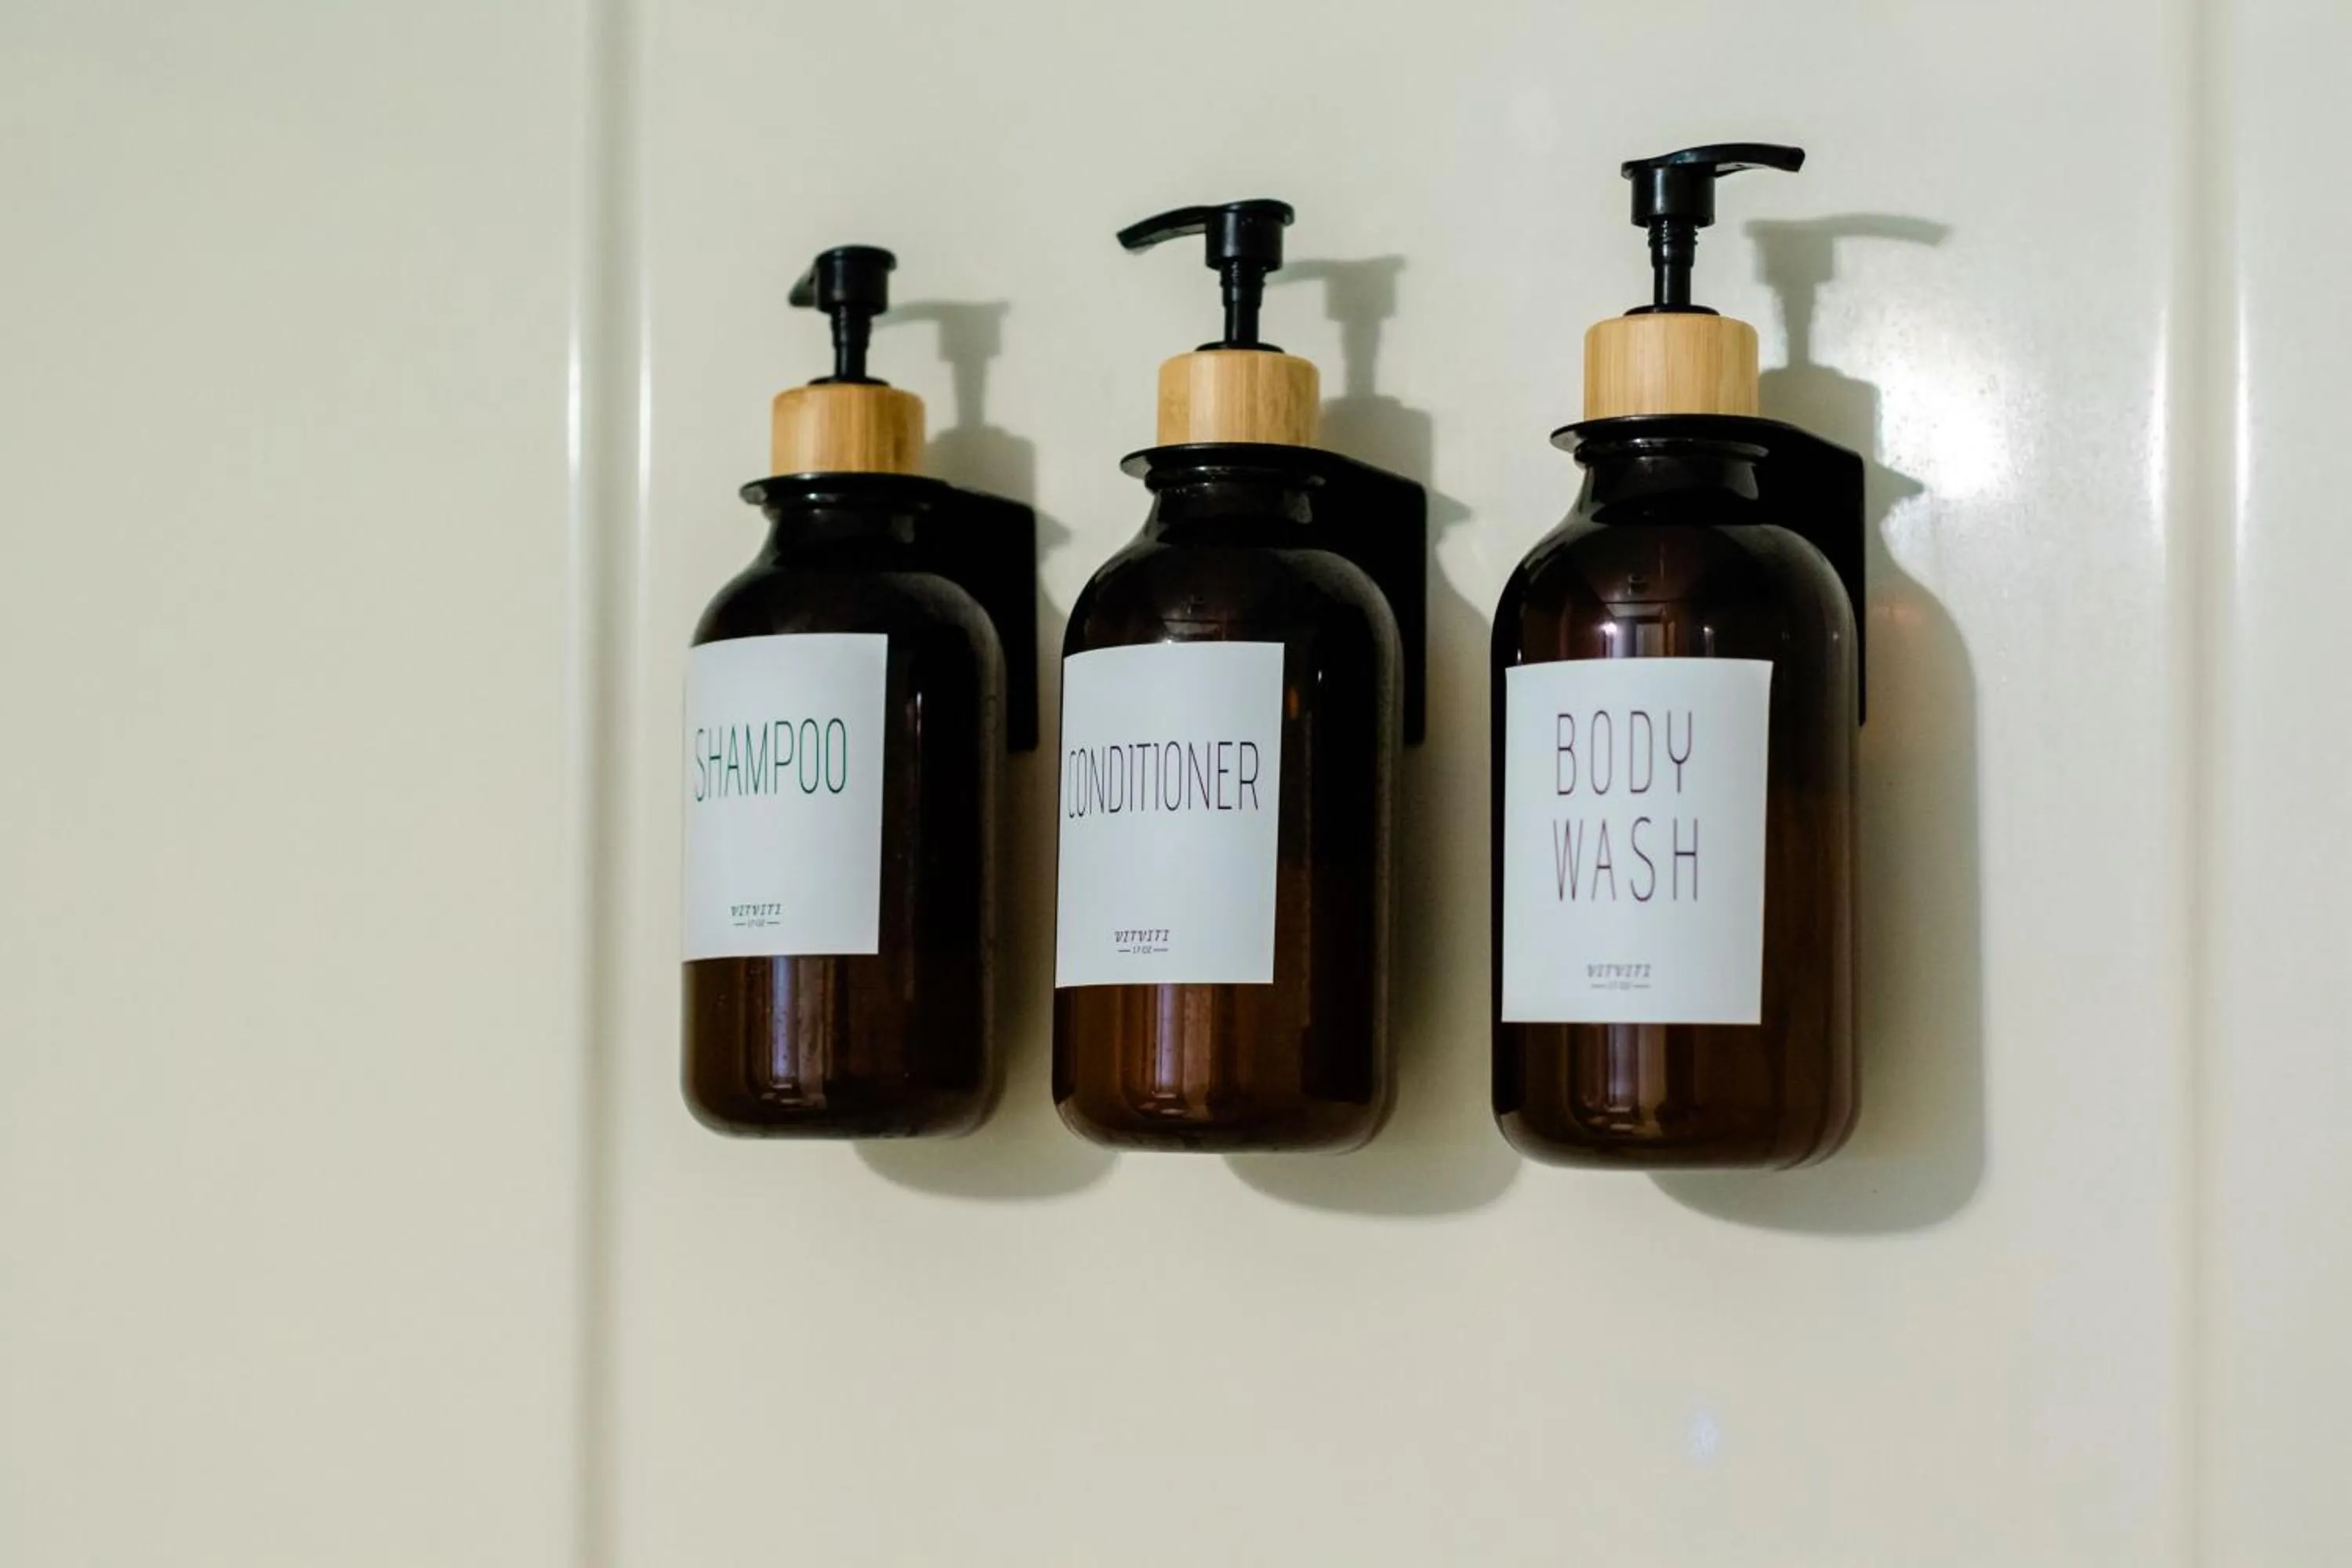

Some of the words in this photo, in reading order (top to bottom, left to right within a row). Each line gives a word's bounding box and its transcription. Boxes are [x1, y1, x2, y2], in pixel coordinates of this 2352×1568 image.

[695, 718, 847, 802] SHAMPOO
[1068, 741, 1259, 818] CONDITIONER
[1556, 710, 1692, 796] BODY
[1552, 816, 1698, 902] WASH
[1115, 929, 1170, 942] VITVITI
